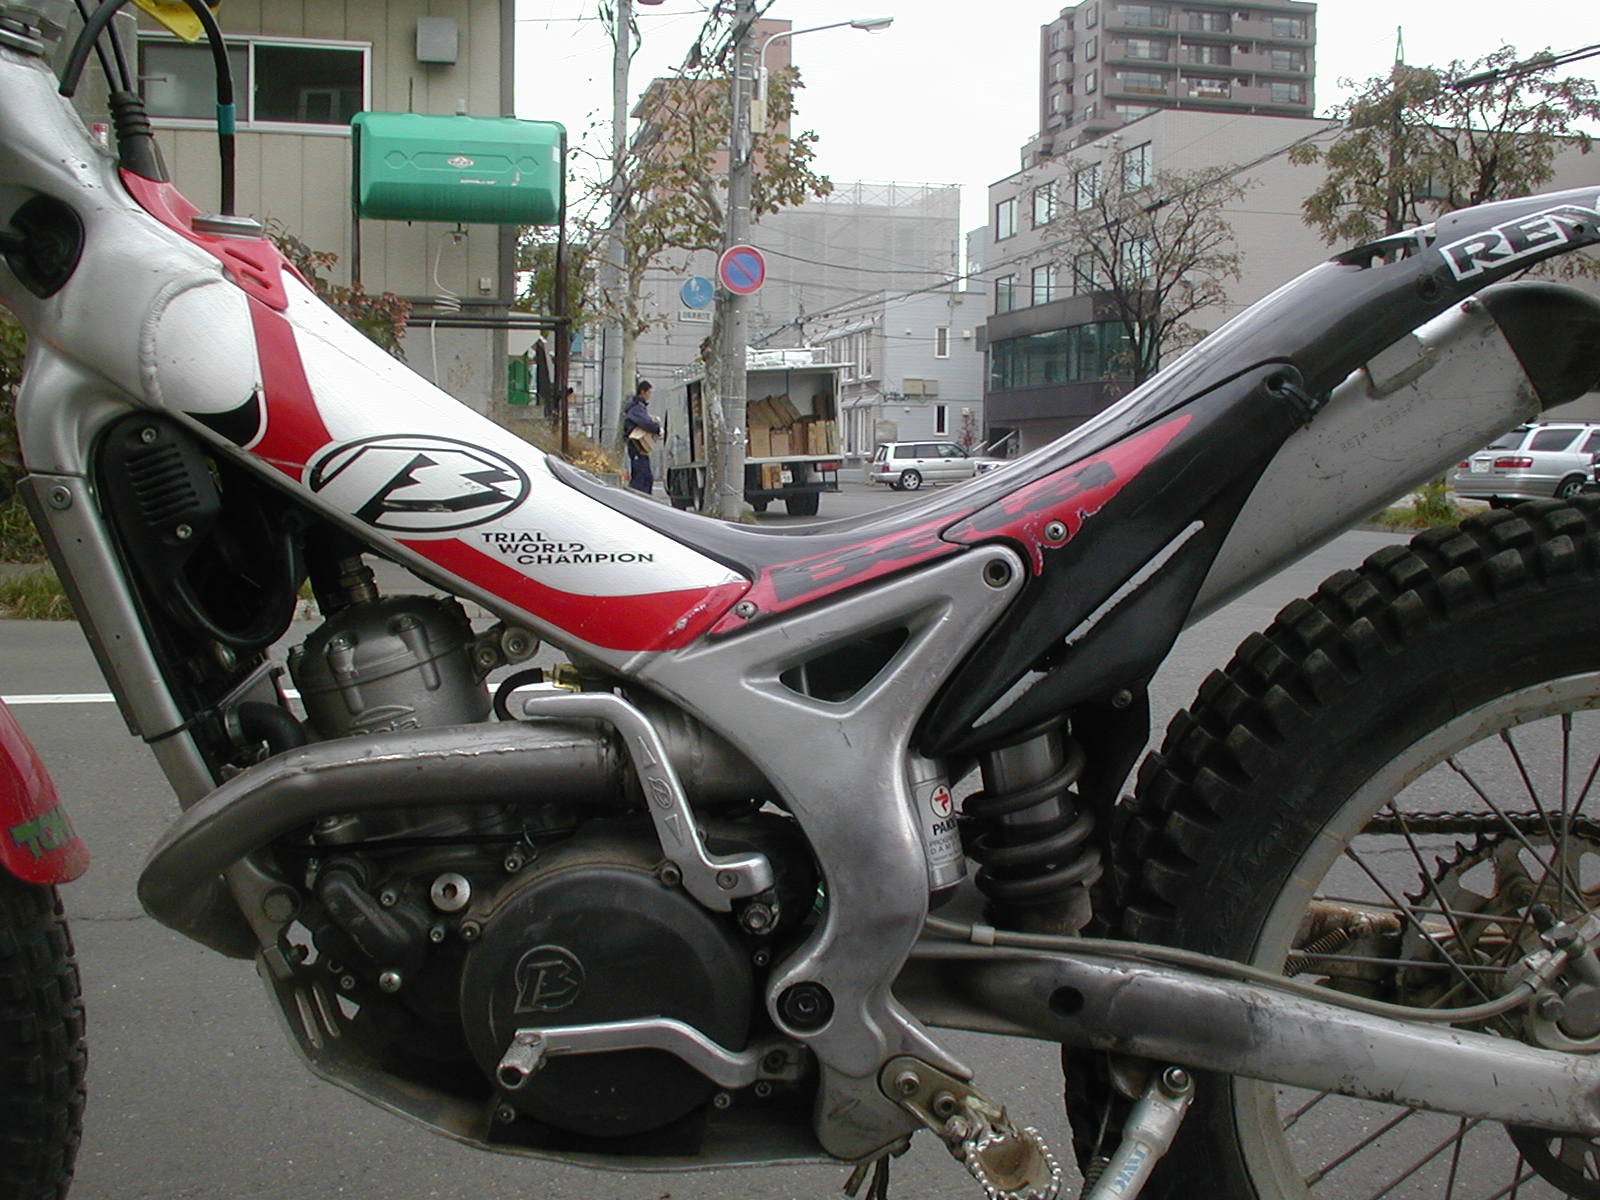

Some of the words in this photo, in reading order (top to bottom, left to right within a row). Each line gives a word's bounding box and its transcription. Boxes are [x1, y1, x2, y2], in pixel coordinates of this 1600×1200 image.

[482, 532, 547, 542] TRIAL
[499, 543, 585, 554] WORLD
[517, 553, 654, 565] CHAMPION
